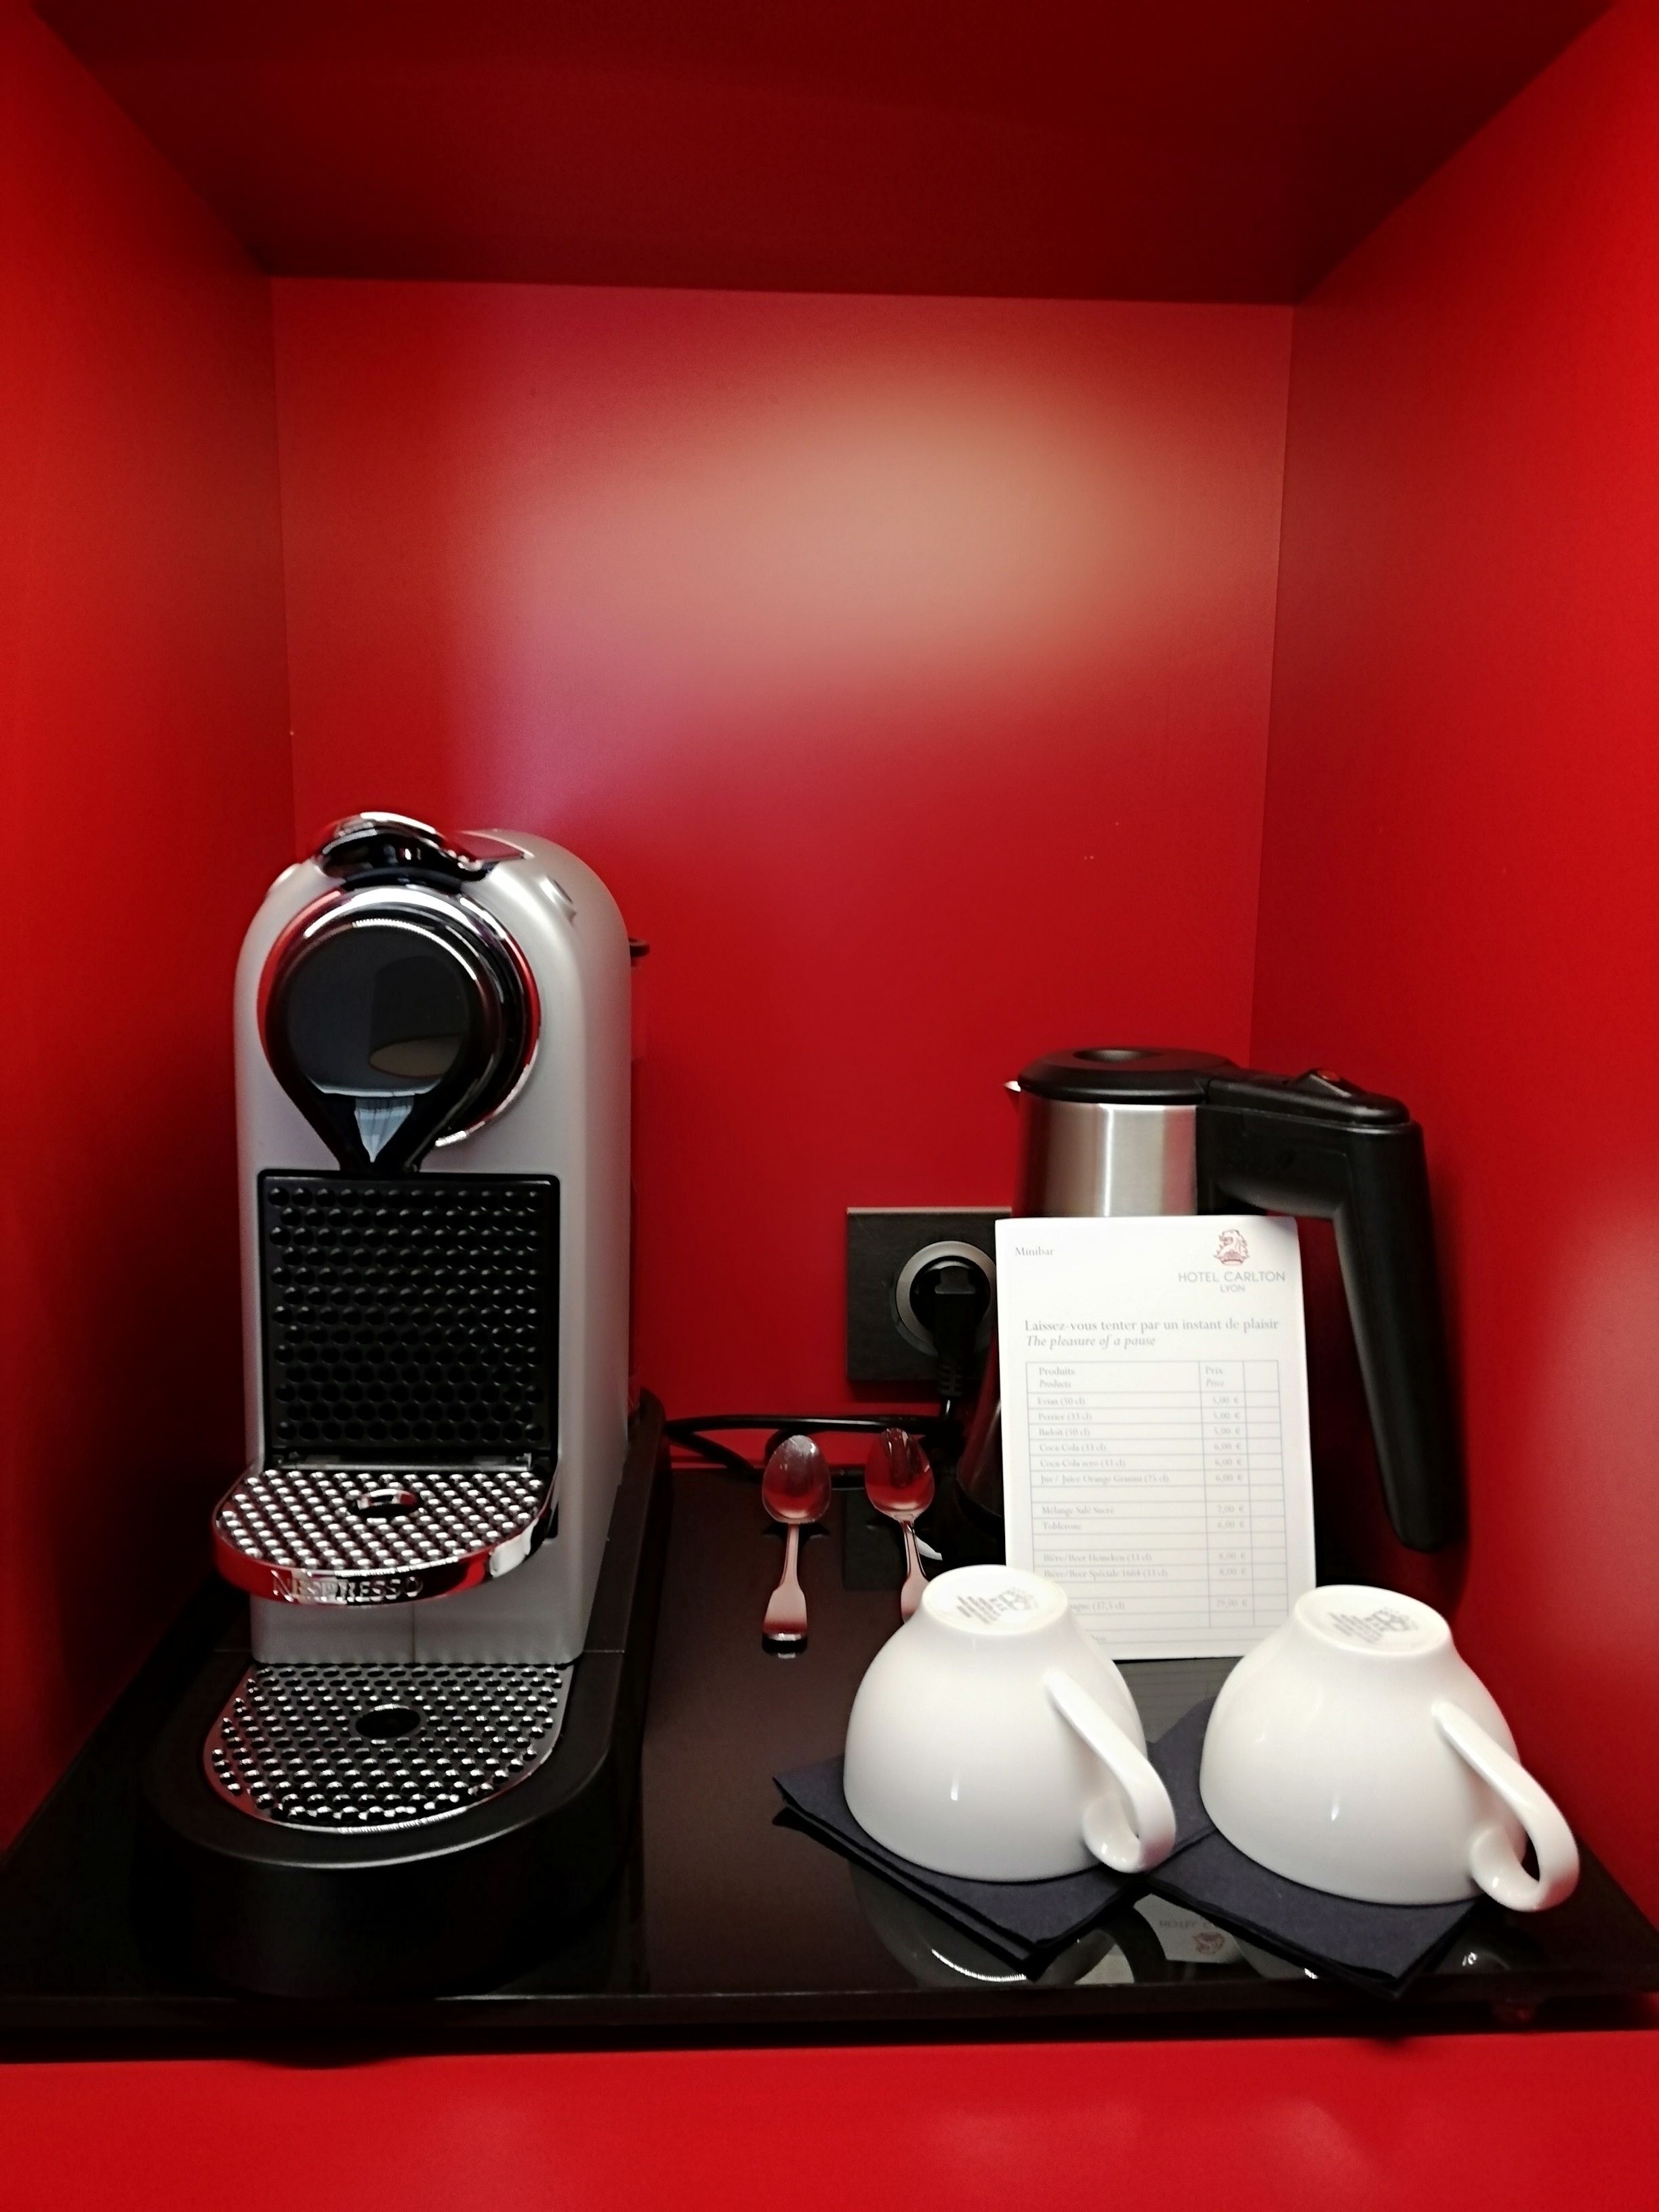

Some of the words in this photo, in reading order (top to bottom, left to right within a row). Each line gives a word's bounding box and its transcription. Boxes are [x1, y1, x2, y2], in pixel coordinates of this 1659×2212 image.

[1015, 1246, 1054, 1256] Minibar
[1178, 1271, 1218, 1282] HOTEL
[1224, 1271, 1285, 1282] CARLTON
[1220, 1284, 1245, 1292] LYON
[1025, 1320, 1097, 1331] Laissez-vous
[1101, 1321, 1136, 1331] tenter
[1141, 1322, 1159, 1334] par
[1183, 1319, 1221, 1330] instant
[1225, 1318, 1240, 1330] de
[1243, 1317, 1279, 1333] plaisir
[1026, 1336, 1046, 1347] The
[1050, 1335, 1096, 1349] pleasure
[1099, 1334, 1111, 1349] of
[1114, 1338, 1120, 1346] a
[1124, 1336, 1156, 1349] pause
[1039, 1366, 1075, 1375] Produits
[1206, 1366, 1223, 1374] Prix
[1039, 1379, 1071, 1388] Products
[1206, 1378, 1225, 1387] Price
[1038, 1397, 1058, 1405] Evian
[1038, 1412, 1064, 1420] Perrier
[1039, 1428, 1063, 1436] Badoit
[1040, 1443, 1079, 1452] Coca-Cola
[1040, 1459, 1080, 1467] Coca-Cola
[1089, 1553, 1126, 1561] Heineken
[272, 1570, 424, 1603] NESPRESSO
